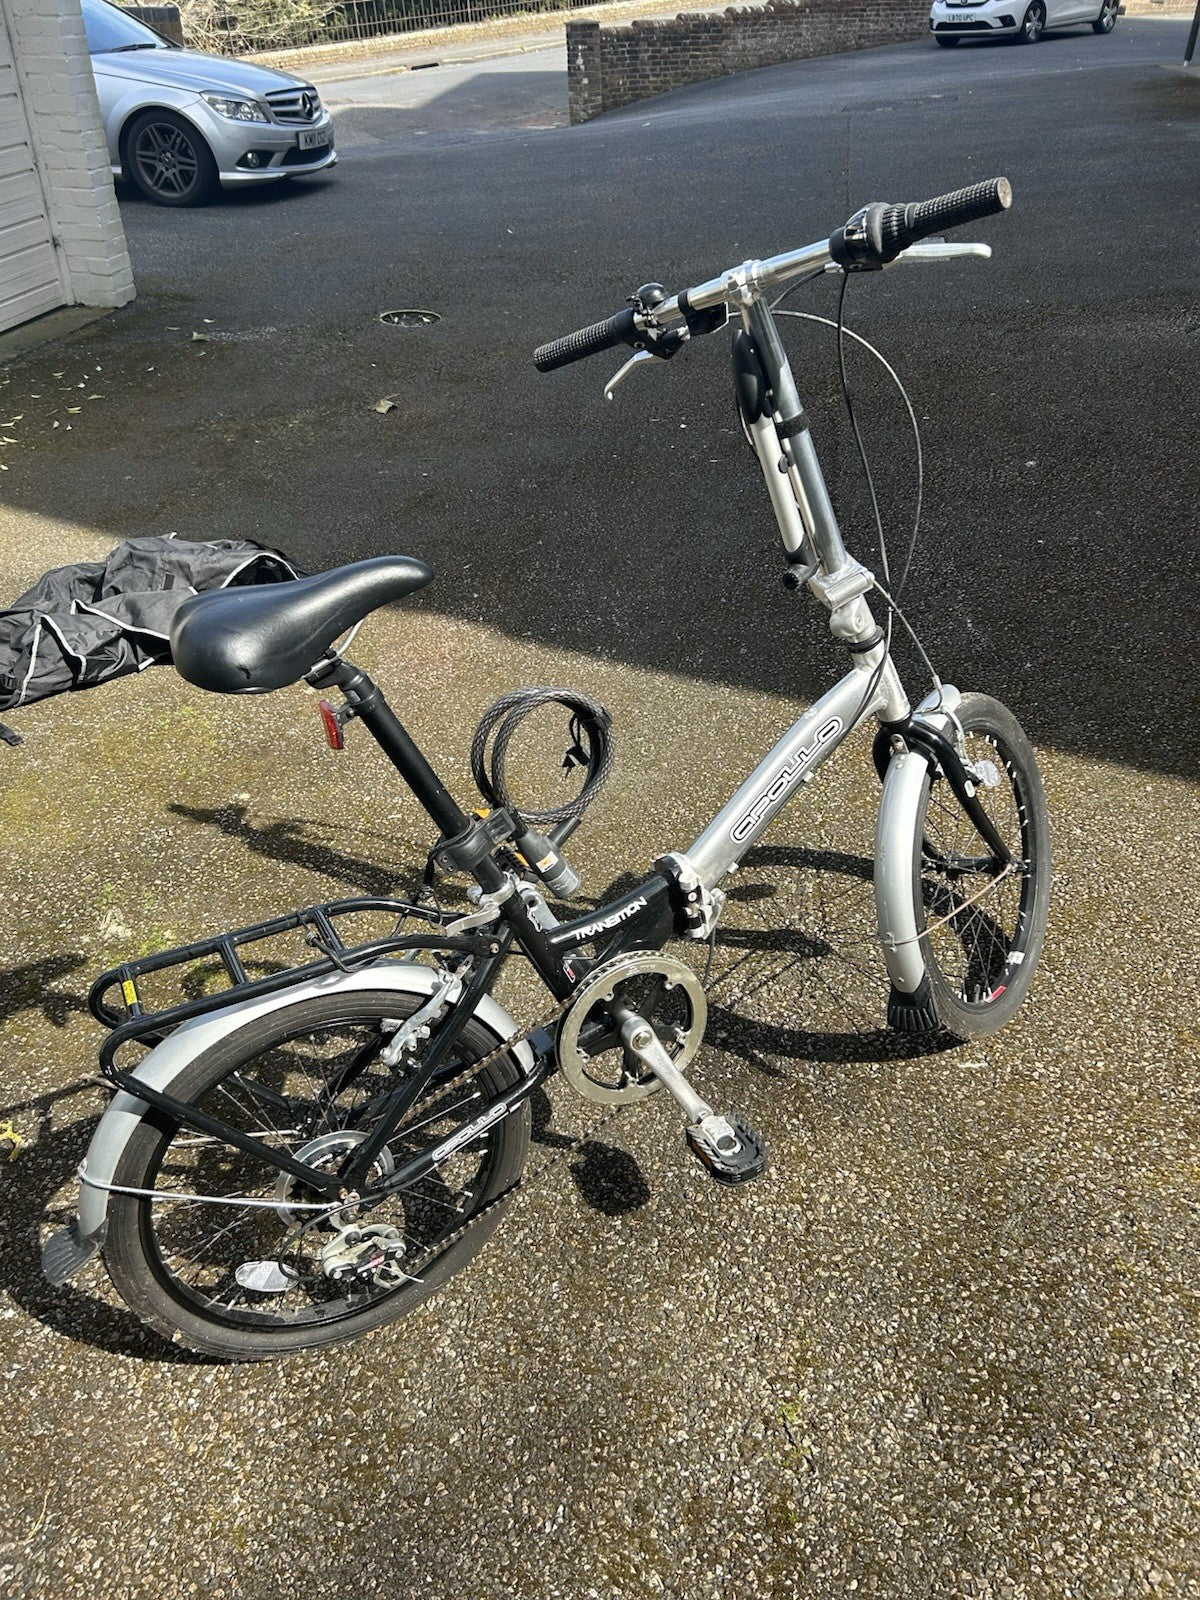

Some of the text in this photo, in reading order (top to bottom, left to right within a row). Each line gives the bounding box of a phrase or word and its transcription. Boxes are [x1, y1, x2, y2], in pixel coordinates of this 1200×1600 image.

[731, 717, 841, 842] APOLLO
[572, 896, 648, 940] TRANSITION
[432, 1102, 507, 1161] APOLLO
